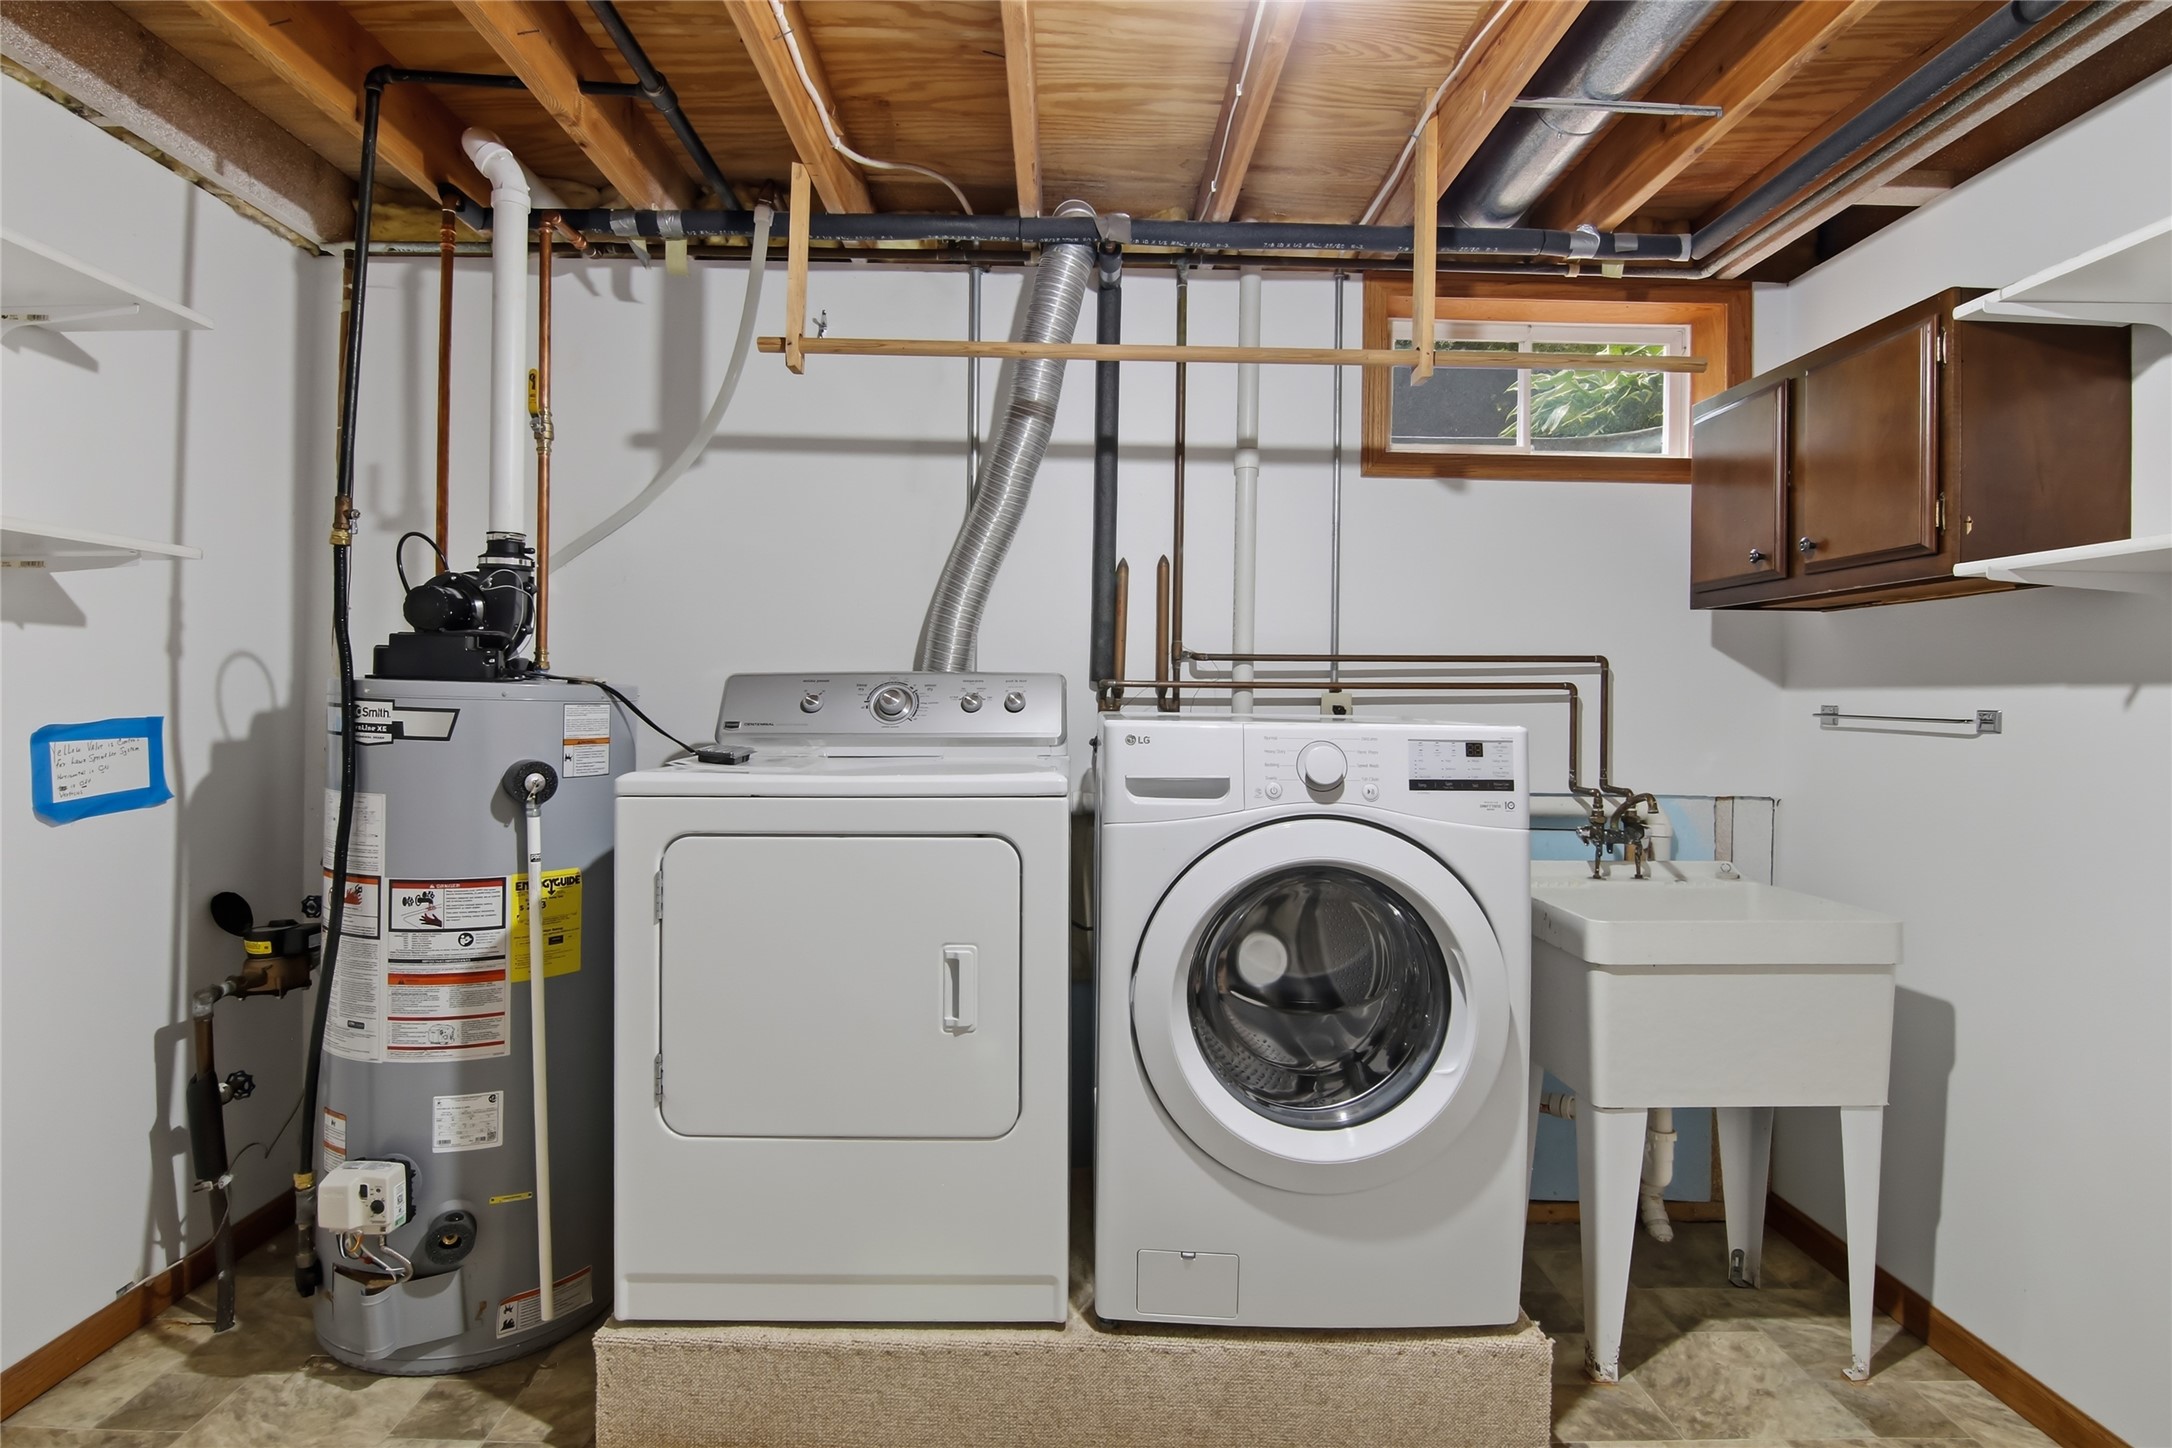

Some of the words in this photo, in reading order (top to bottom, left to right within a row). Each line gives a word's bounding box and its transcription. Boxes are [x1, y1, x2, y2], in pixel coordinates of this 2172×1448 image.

[362, 707, 390, 718] Smith
[1138, 736, 1150, 744] LG
[50, 742, 80, 761] Yellow
[516, 875, 580, 893] ENGYGUIDE
